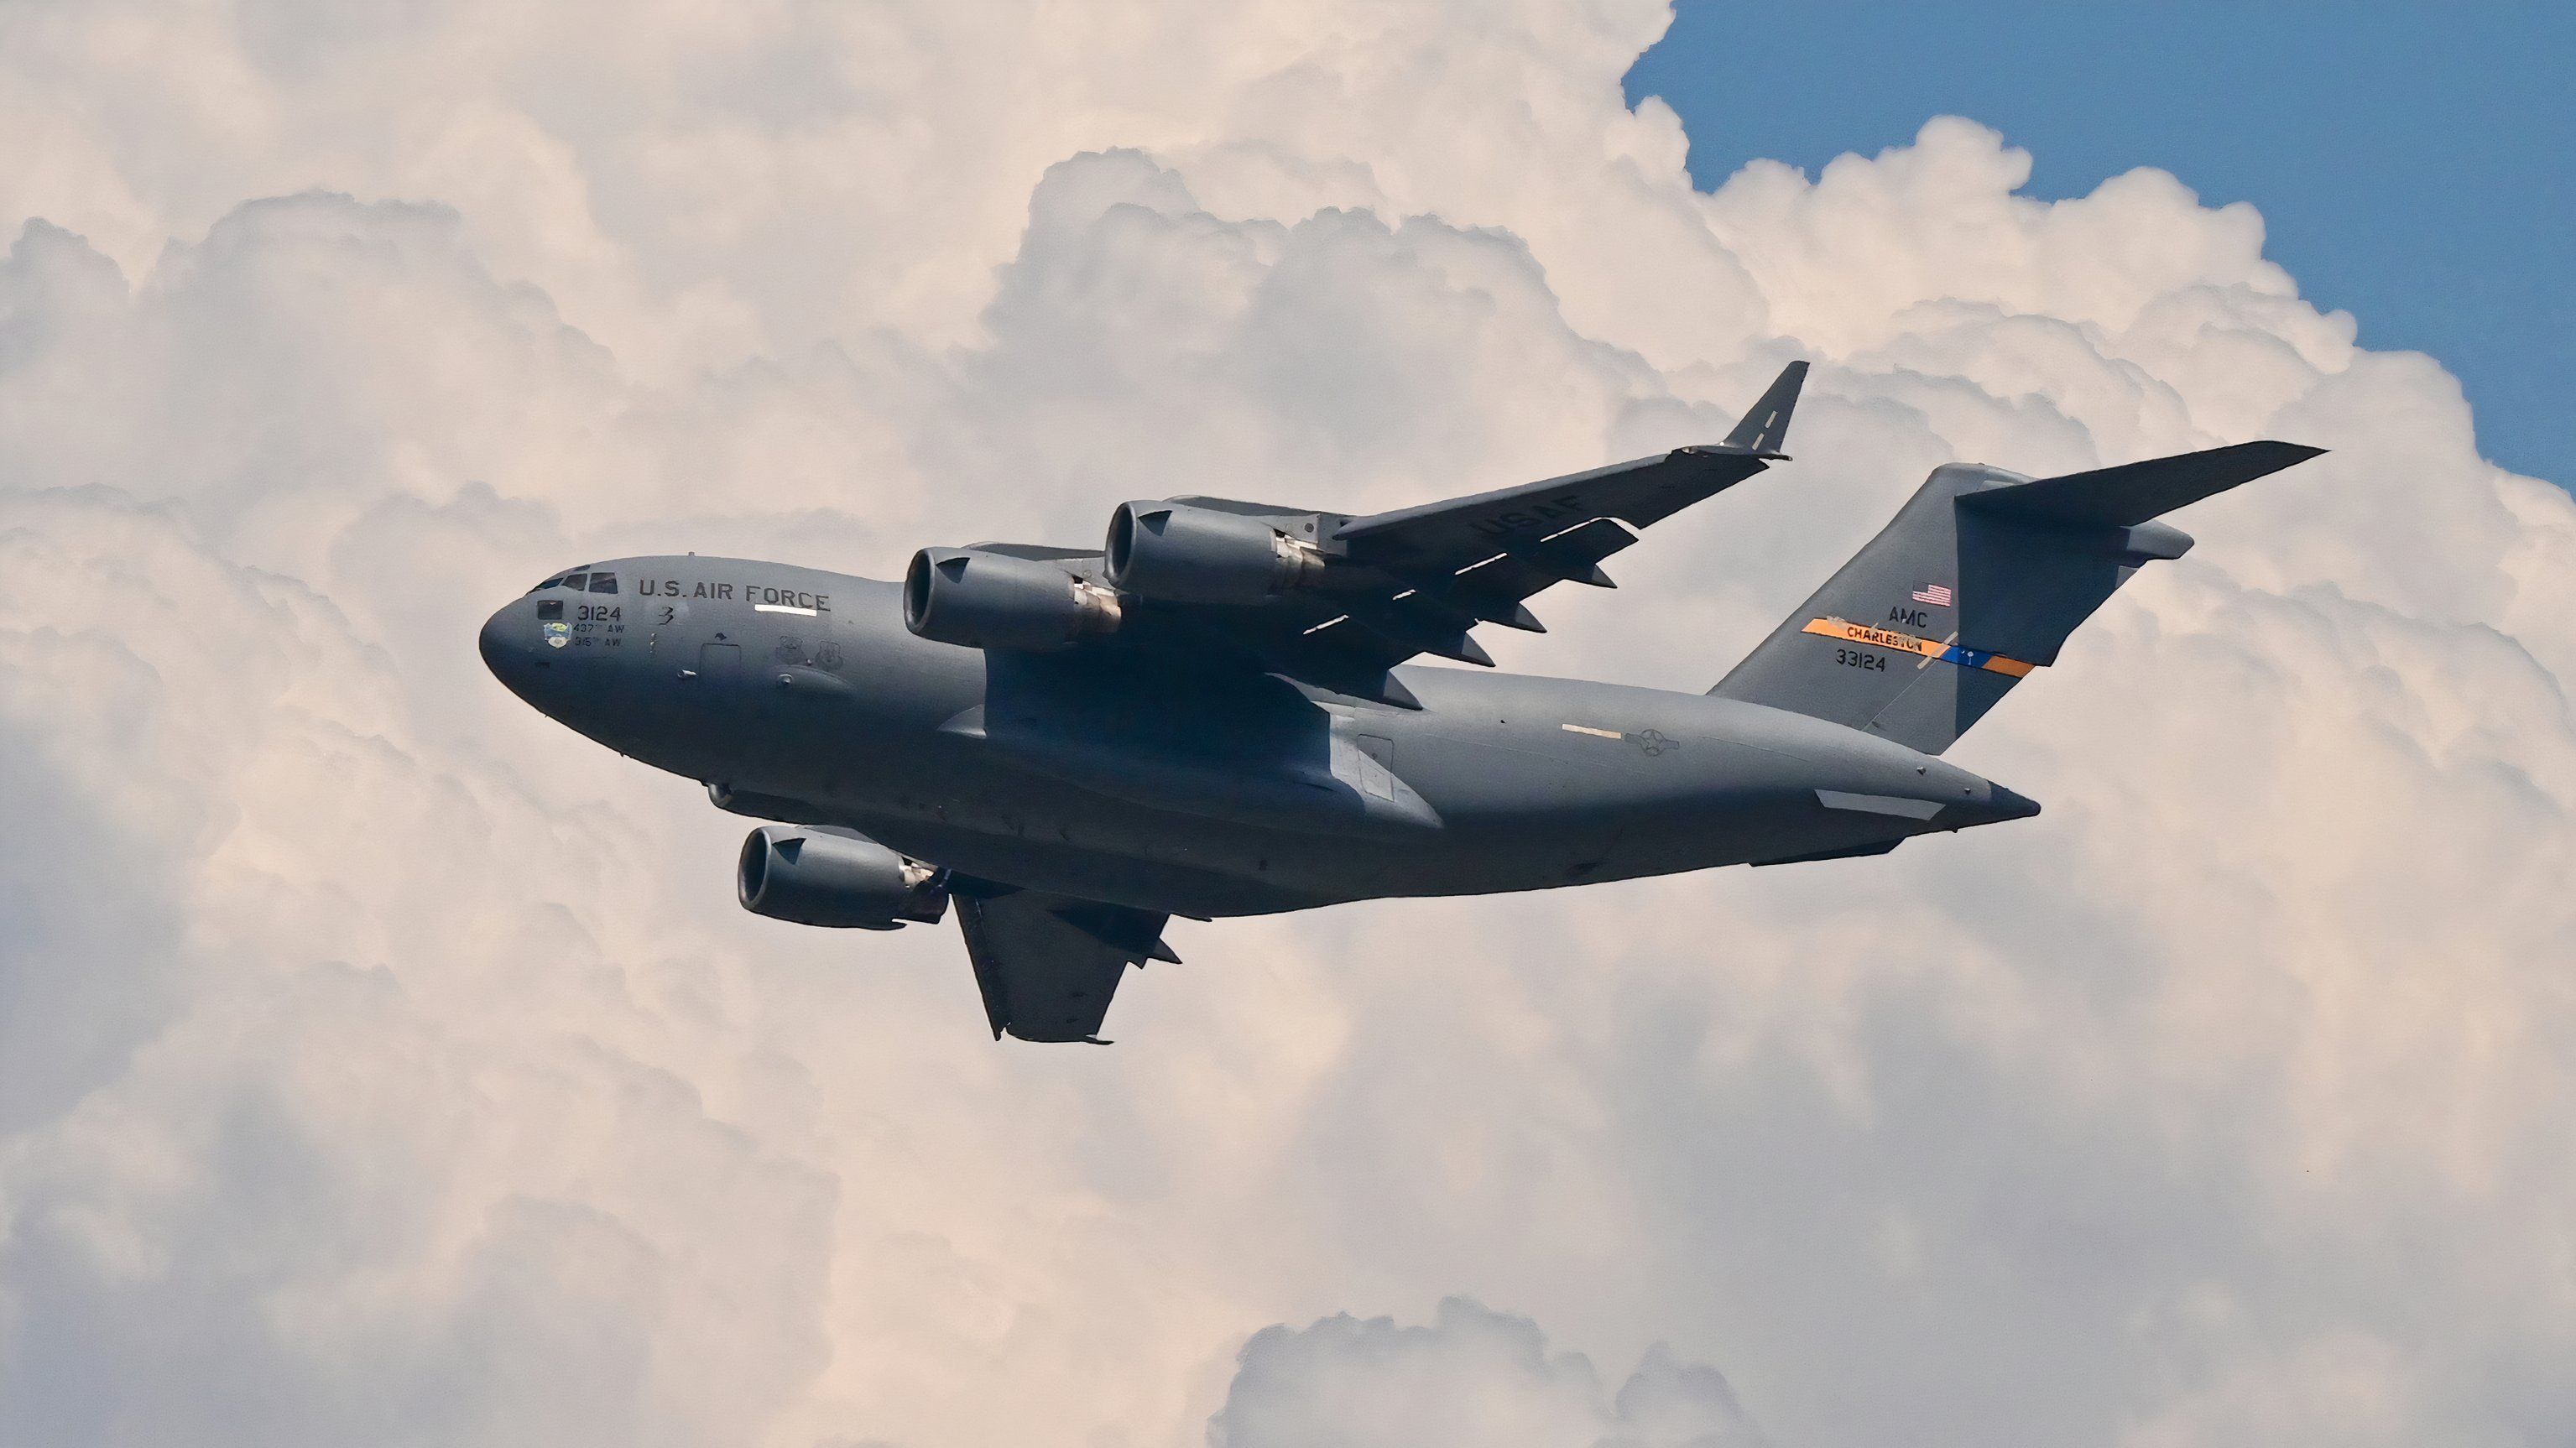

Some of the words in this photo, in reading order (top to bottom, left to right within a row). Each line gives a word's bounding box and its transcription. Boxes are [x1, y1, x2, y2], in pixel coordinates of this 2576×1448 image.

[639, 579, 687, 598] U.S.
[693, 582, 733, 601] AIR
[745, 585, 832, 612] FORCE
[577, 605, 621, 622] 3124
[1889, 606, 1928, 628] AMC
[1835, 648, 1886, 673] 33124
